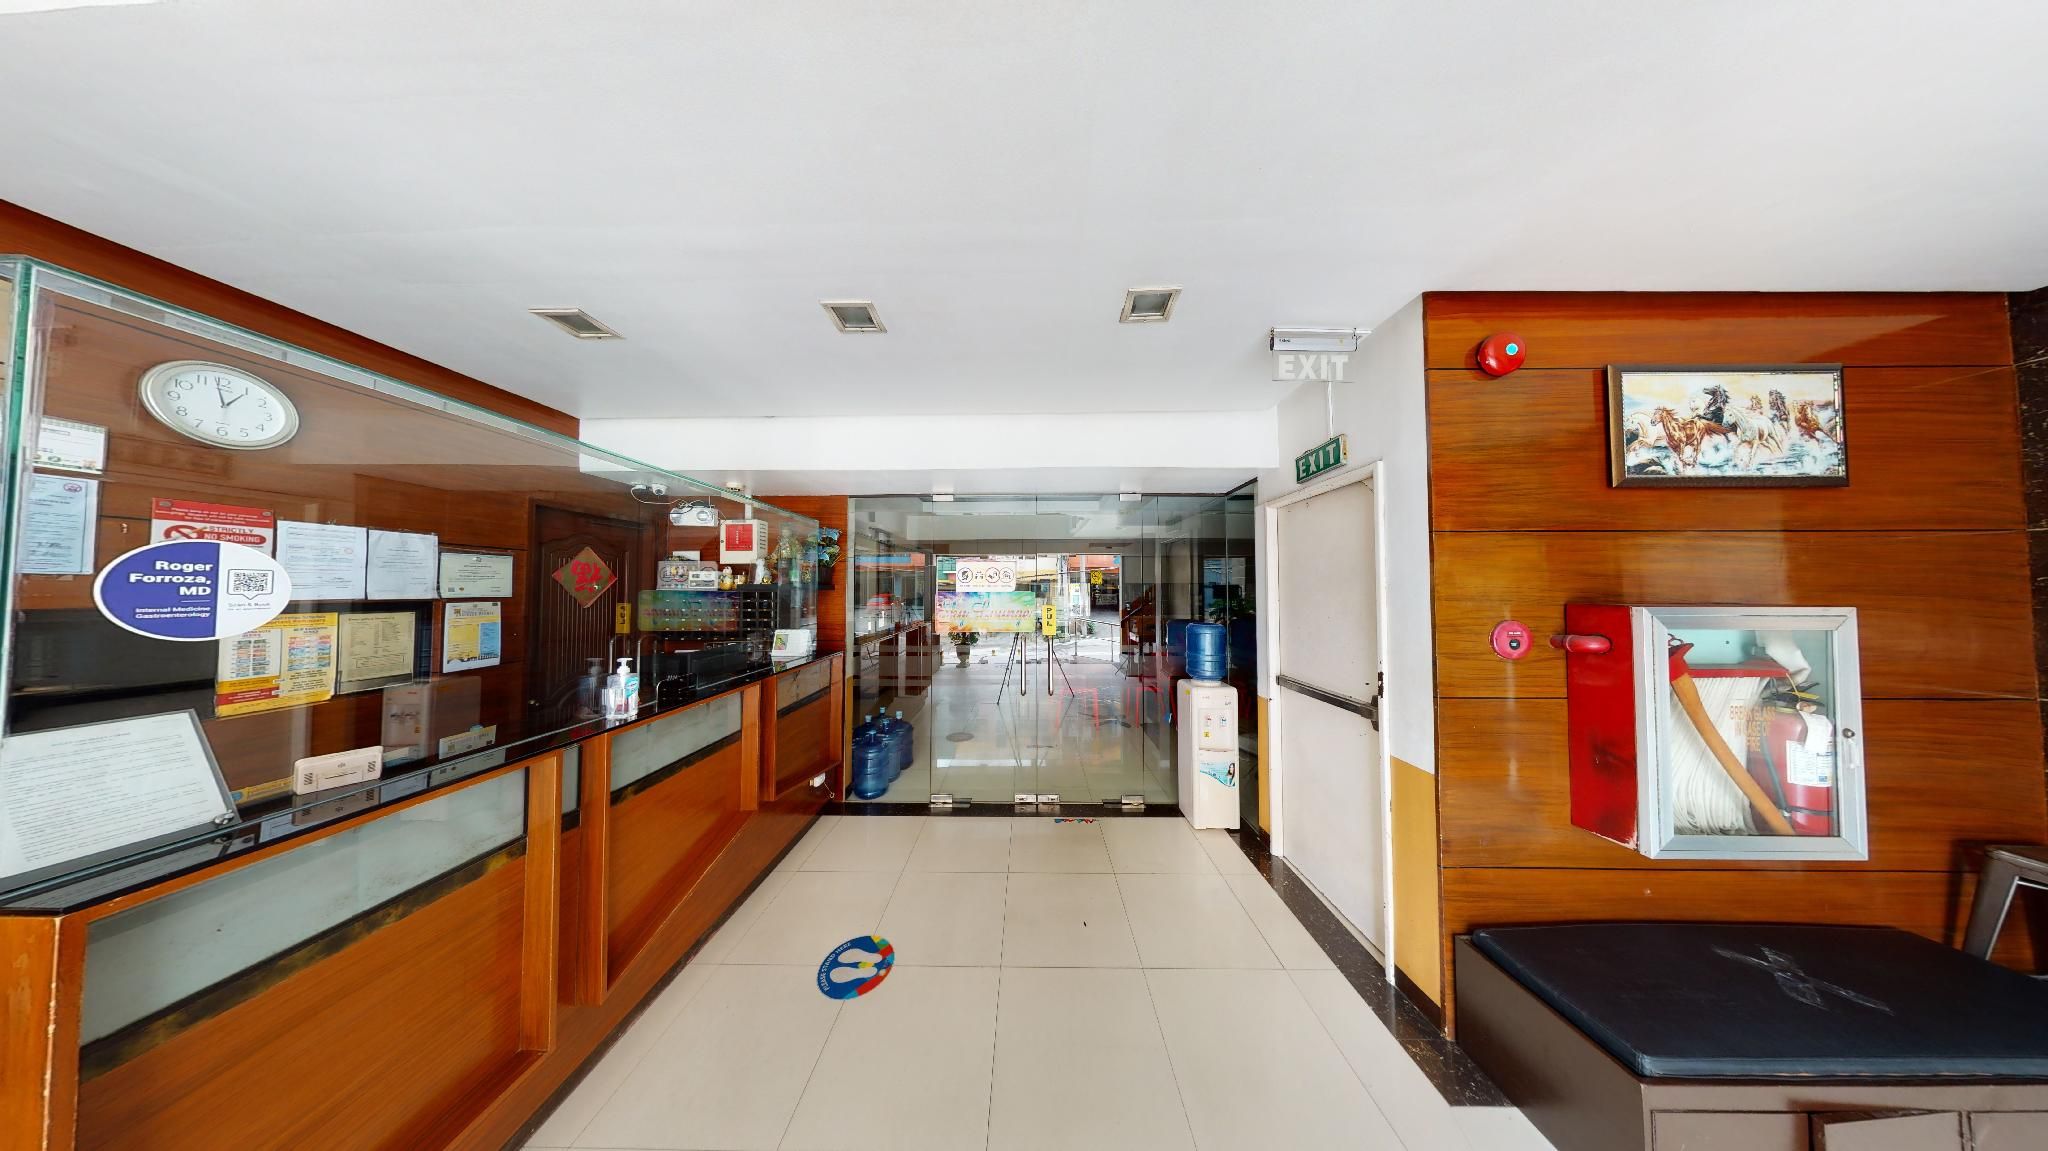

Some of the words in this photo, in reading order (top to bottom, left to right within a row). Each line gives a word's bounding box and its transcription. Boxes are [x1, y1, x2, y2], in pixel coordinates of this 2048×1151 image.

[1278, 354, 1349, 381] EXIT
[175, 379, 194, 391] 10
[197, 374, 208, 386] 11
[167, 390, 181, 401] 9
[258, 397, 267, 409] 2
[175, 405, 188, 417] 8
[264, 412, 273, 422] 3
[194, 418, 204, 428] 7
[256, 423, 265, 433] 4
[216, 426, 229, 437] 6
[240, 427, 249, 438] 5
[1298, 443, 1337, 476] EXIT
[209, 525, 255, 534] STRICTLY
[204, 532, 218, 540] NO
[220, 533, 261, 543] SMOKING
[155, 560, 214, 573] Roger
[129, 573, 212, 585] Forroza,
[179, 586, 212, 596] MD
[821, 953, 836, 973] STAND
[820, 972, 831, 992] PLEASE
